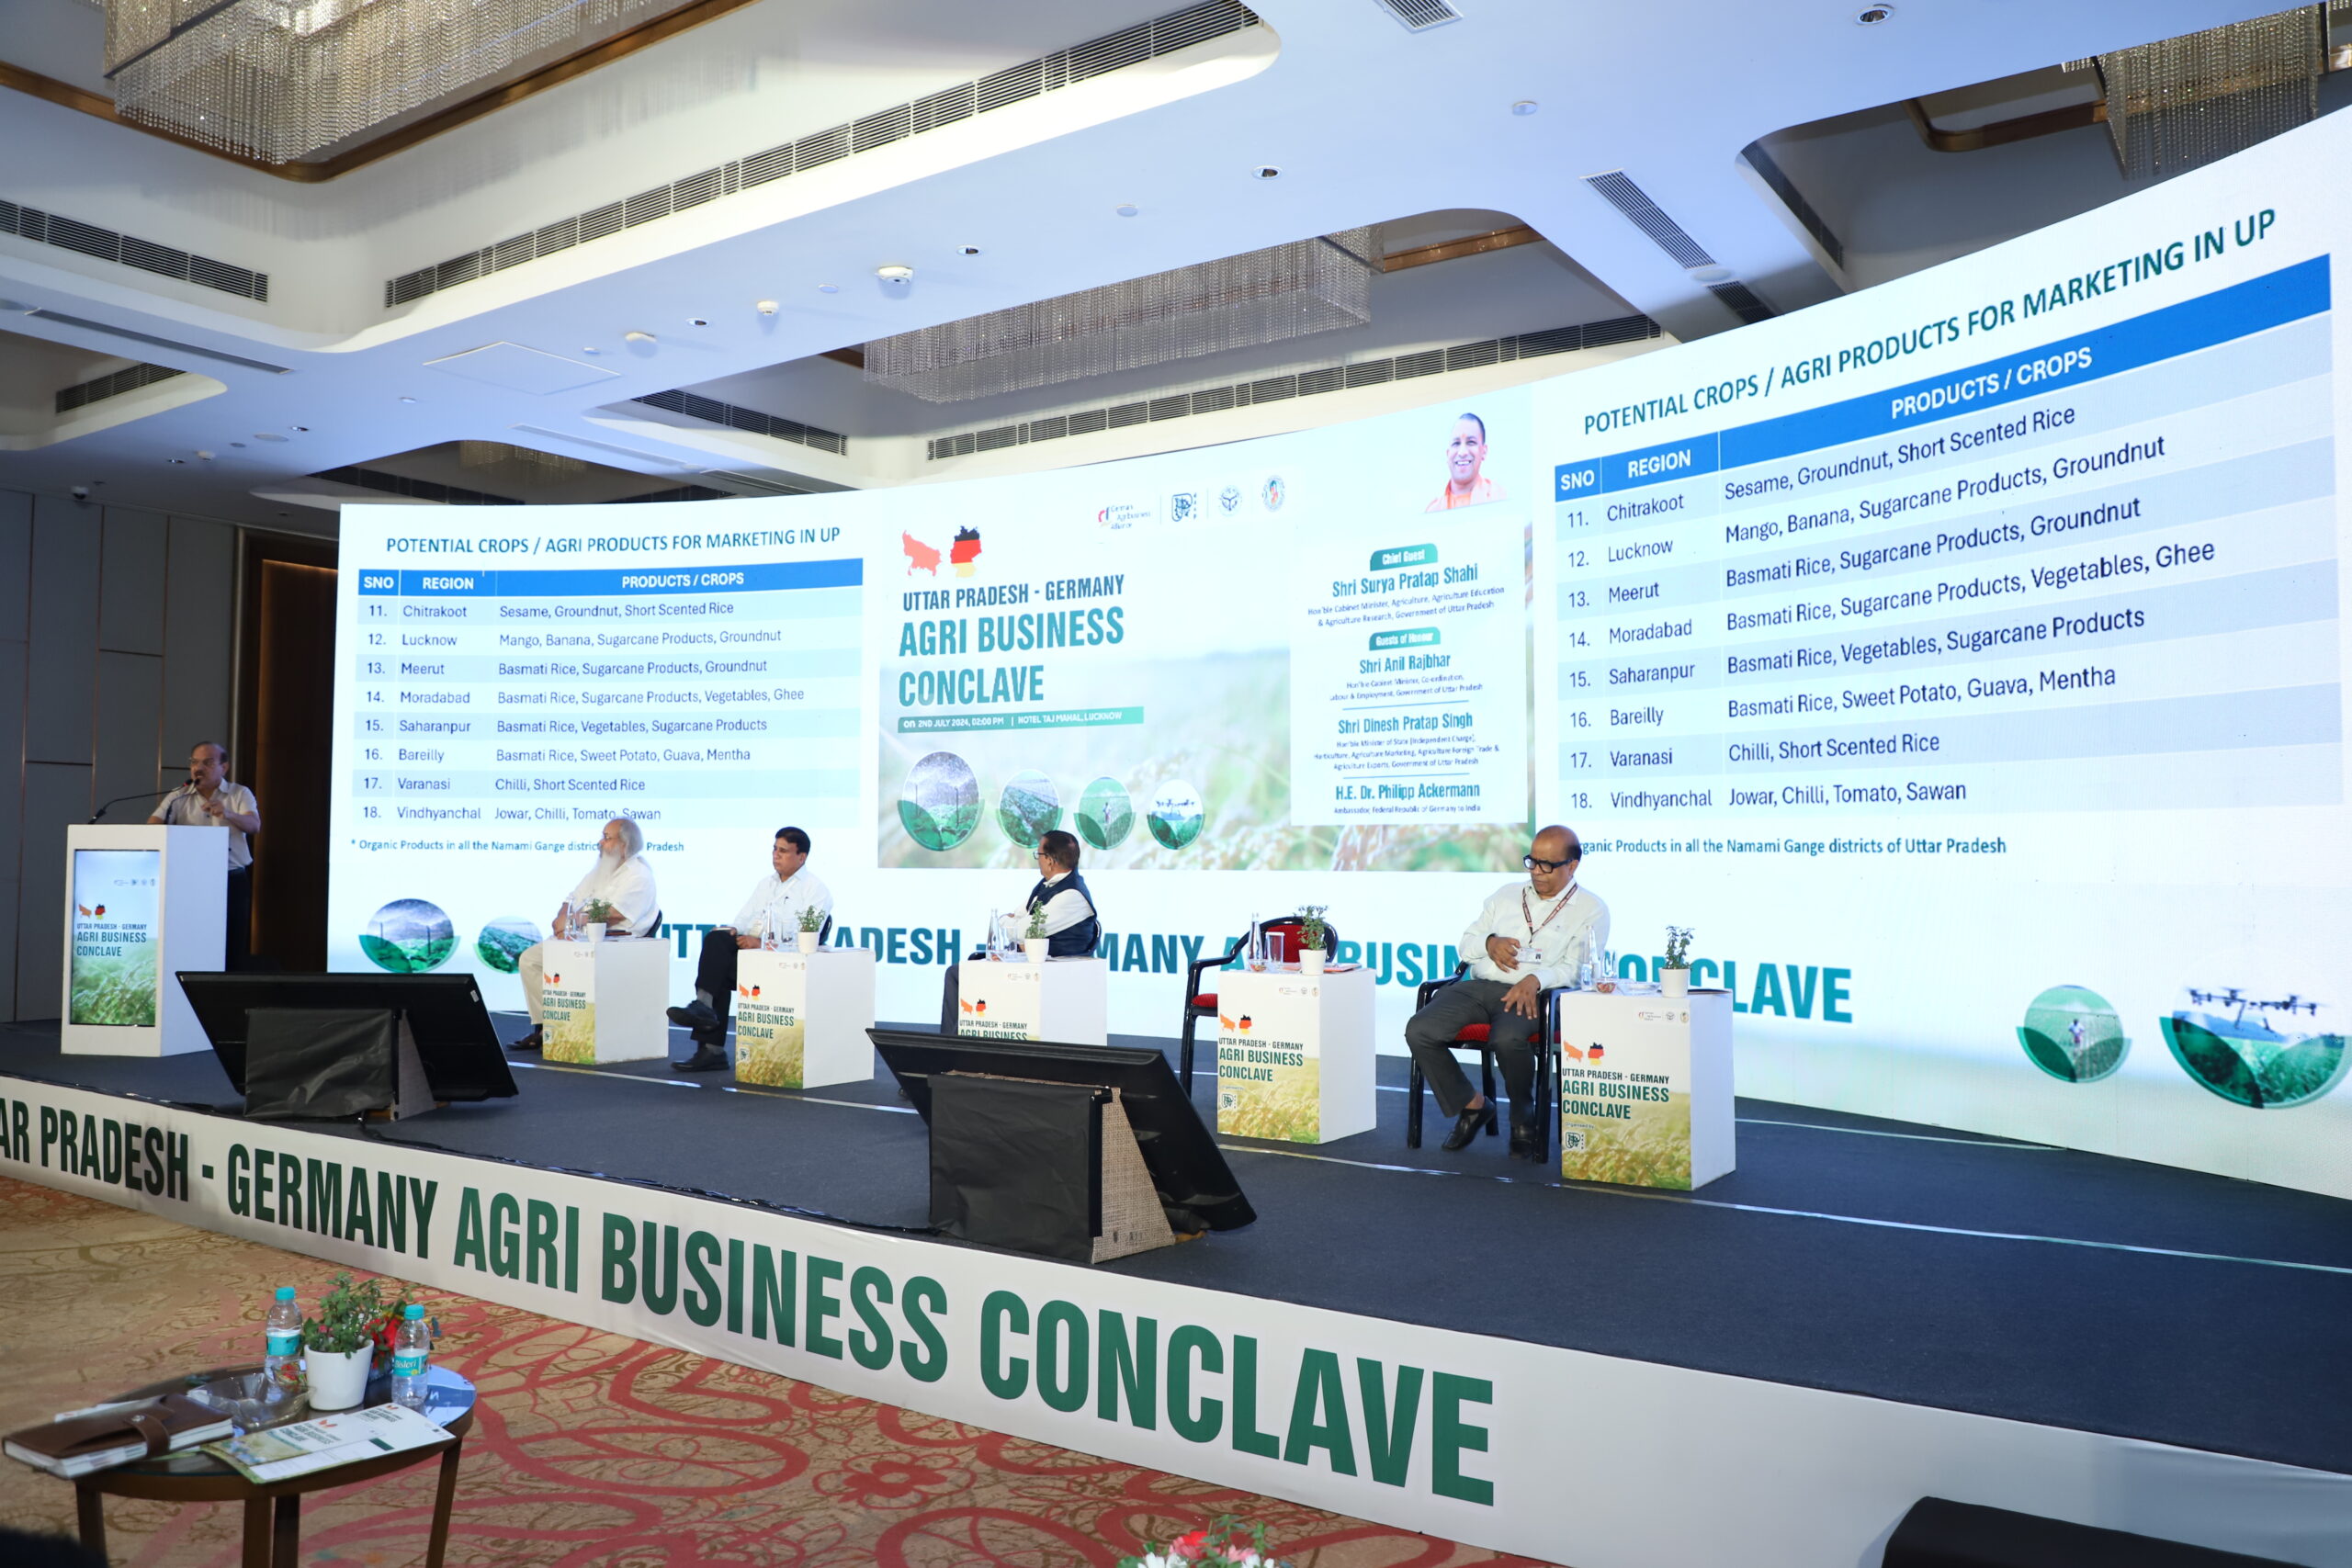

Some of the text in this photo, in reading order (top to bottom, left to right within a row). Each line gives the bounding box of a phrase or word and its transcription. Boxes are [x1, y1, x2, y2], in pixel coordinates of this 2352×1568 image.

[1585, 393, 1689, 435] POTENTIAL
[1693, 375, 1758, 410] CROPS
[1781, 354, 1831, 389] AGRI
[1838, 316, 1960, 373] PRODUCTS
[1968, 299, 2016, 336] FOR
[2023, 241, 2185, 319] MARKETING
[2194, 226, 2224, 263] IN
[2234, 209, 2276, 247] UP
[1560, 469, 1595, 491] SNO
[1628, 449, 1690, 479] REGION
[1892, 373, 2000, 419] PRODUCTS
[2017, 346, 2092, 385] CROPS
[1567, 408, 2075, 528] 11. Chitrakoot Sesame, Groundnut, Short Scented Rice
[1332, 563, 1478, 598] Shri Surya Pratap Shahi
[903, 590, 950, 612] UTTAR
[956, 583, 1029, 608] PRADESH
[1046, 574, 1125, 602] GERMANY
[1569, 543, 2215, 648] 14. Moradabad Basmati Rice, Sugarcane Products, Vegetables, Ghee
[899, 606, 1125, 657] AGRI BUSINESS
[368, 660, 766, 677] 13. Meerut Basmati Rice, Sugarcane Products, Groundnut
[1360, 654, 1451, 674] Shri Anil Rajbhar
[899, 664, 1044, 706] CONCLAVE
[933, 719, 950, 728] JULY
[951, 718, 970, 727] 2024,
[972, 717, 991, 726] 02:00
[992, 717, 1004, 726] PM
[1018, 711, 1123, 724] HOTEL TAJ MAHAL, LUCKNOW
[1338, 712, 1473, 734] Shri Dinesh Pratap Singh
[365, 749, 750, 763] 16. Bareilly Basmati Rice, Sweet Potato, Guava, Mentha
[1336, 783, 1480, 801] H.E. Dr. Philipp Ackermann
[1571, 782, 1966, 811] 18. Vindhyanchal Jowar, Chilli, Tomato, Sawan
[359, 840, 565, 852] Organic Products in all the Namami Gange
[647, 841, 684, 852] Pradesh
[1616, 839, 1668, 852] Products
[1670, 839, 1681, 852] in
[1686, 838, 1700, 852] all
[1702, 838, 1724, 852] the
[1727, 838, 1781, 852] Namami
[1784, 839, 1825, 857] Gange
[1828, 838, 1883, 853] districts
[1886, 838, 1902, 853] of
[1905, 838, 1942, 853] Uttar
[1947, 837, 2007, 853] Pradesh
[76, 931, 147, 943] AGRI BUSINESS
[76, 946, 122, 957] CONCLAVE
[738, 1011, 795, 1026] AGRI BUSINESS
[738, 1025, 774, 1039] CONCLAVE
[1219, 1037, 1237, 1045] UTTAR
[1238, 1039, 1267, 1048] PRADESH
[1272, 1041, 1304, 1051] GERMANY
[1219, 1048, 1304, 1066] AGRI BUSINESS
[1219, 1066, 1273, 1082] CONCLAVE
[1562, 1068, 1585, 1077] UTTAR
[1587, 1070, 1623, 1081] PRADESH
[1630, 1073, 1669, 1085] GERMANY
[1563, 1079, 1669, 1102] AGRI BUSINESS
[1563, 1100, 1631, 1119] CONCLAVE
[40, 1105, 188, 1202] PRADESH
[228, 1143, 438, 1259] GERMANY
[454, 1187, 579, 1293] AGRI
[602, 1213, 948, 1383] BUSINESS
[980, 1291, 1494, 1506] CONCLAVE
